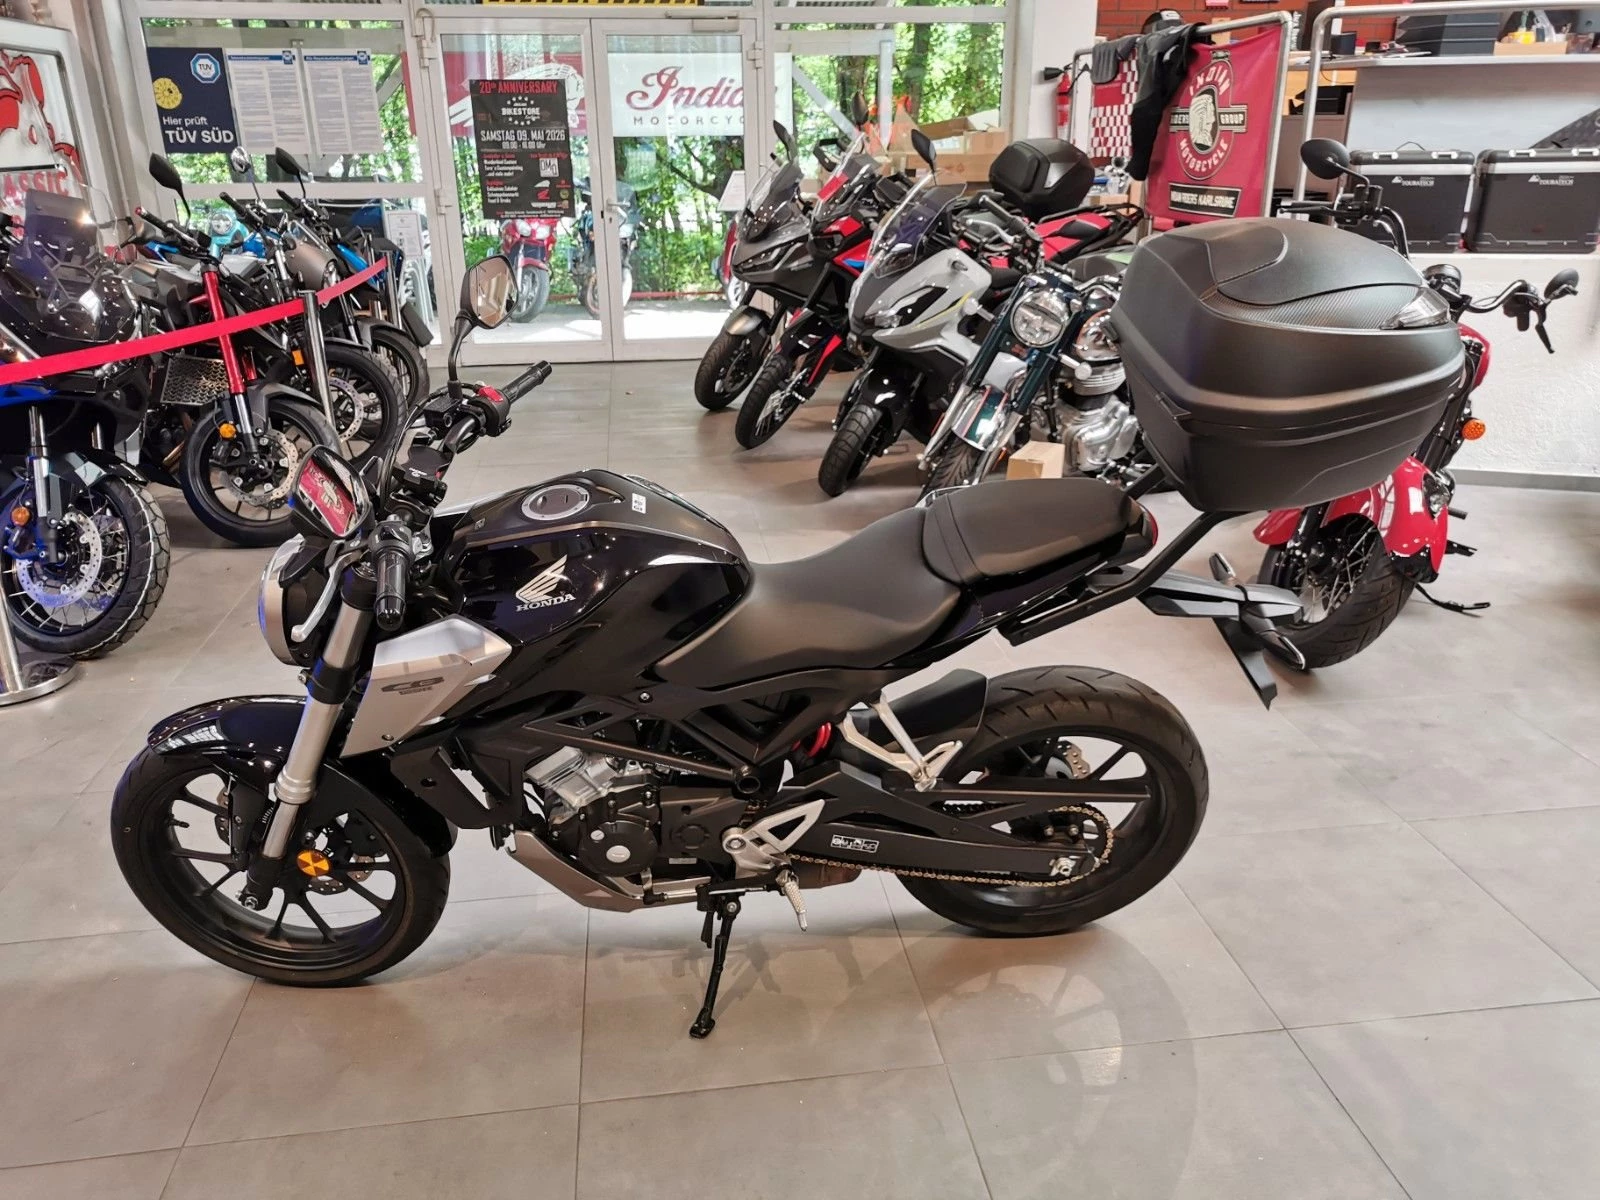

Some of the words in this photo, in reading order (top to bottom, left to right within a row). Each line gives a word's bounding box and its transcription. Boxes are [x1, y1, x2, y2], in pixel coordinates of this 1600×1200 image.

[498, 80, 558, 94] ANNIVERSARY
[1189, 65, 1230, 96] INDIAN
[626, 66, 744, 111] Indi
[501, 107, 540, 116] BIKESTORE
[162, 116, 182, 125] Hier
[184, 116, 208, 126] prüft
[634, 115, 744, 125] MOORCY
[1220, 114, 1245, 125] GROUP
[165, 127, 197, 143] TÜV
[201, 127, 234, 143] SÜD
[480, 129, 515, 142] SAMSTAG
[531, 129, 544, 141] MAI
[545, 129, 566, 141] 2026
[1180, 138, 1228, 172] MOTORCYCLE
[516, 593, 576, 612] HONDA
[381, 676, 445, 692] CB
